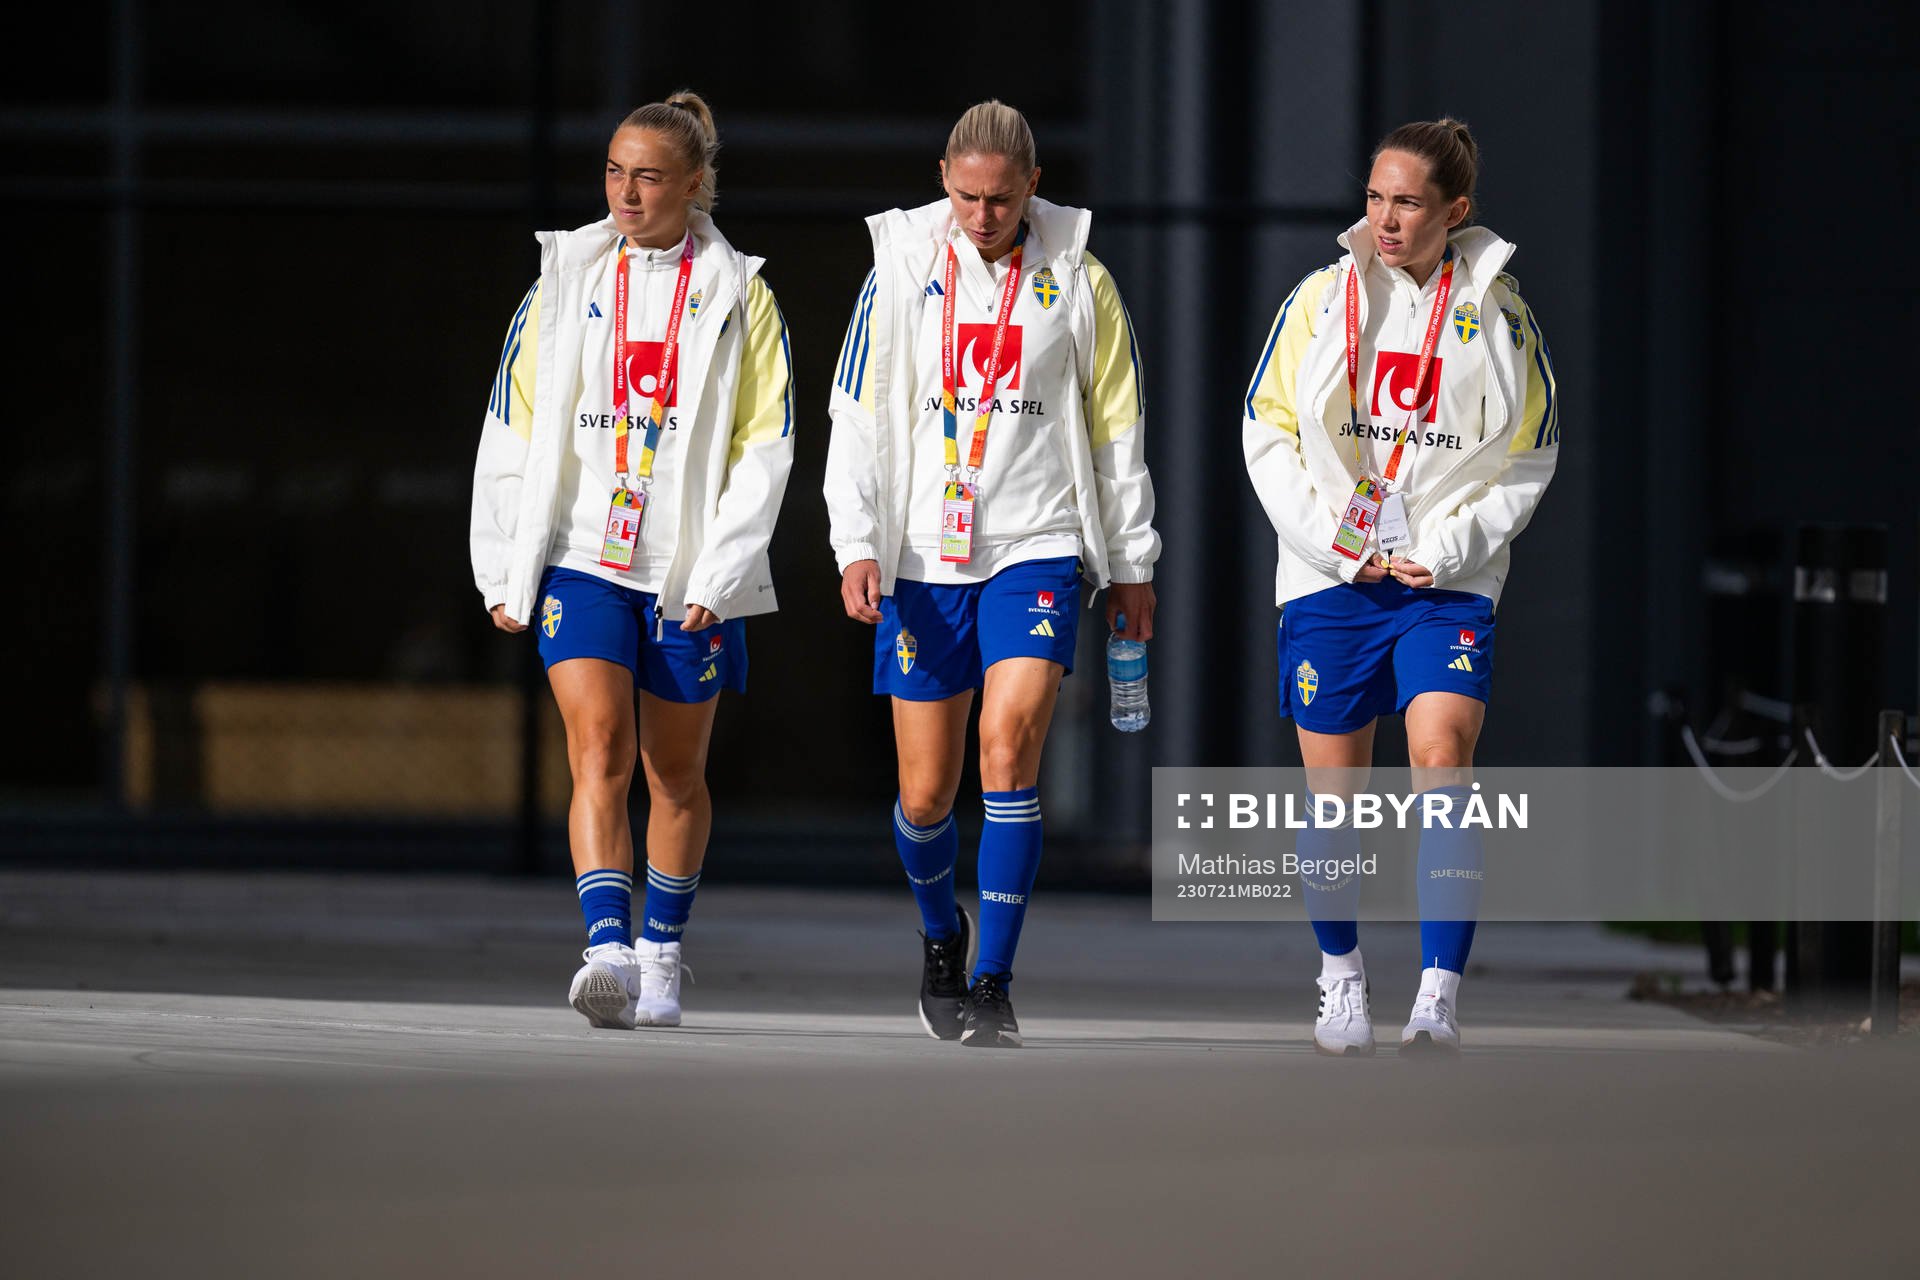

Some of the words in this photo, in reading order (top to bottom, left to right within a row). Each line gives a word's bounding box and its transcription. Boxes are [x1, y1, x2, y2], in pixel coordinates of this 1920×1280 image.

[1001, 306, 1009, 320] CUP
[670, 314, 679, 335] WORLD
[997, 319, 1006, 341] WORLD
[667, 335, 675, 347] CUP
[1423, 337, 1434, 358] WORLD
[1429, 325, 1437, 337] CUP
[987, 371, 995, 384] FIFA
[924, 397, 1003, 412] SVNSA
[1010, 400, 1044, 415] SPEL
[579, 413, 663, 430] SVESK
[1424, 432, 1463, 450] SPEL
[1430, 869, 1484, 880] SVERIGE
[982, 890, 1025, 904] SVERIGE
